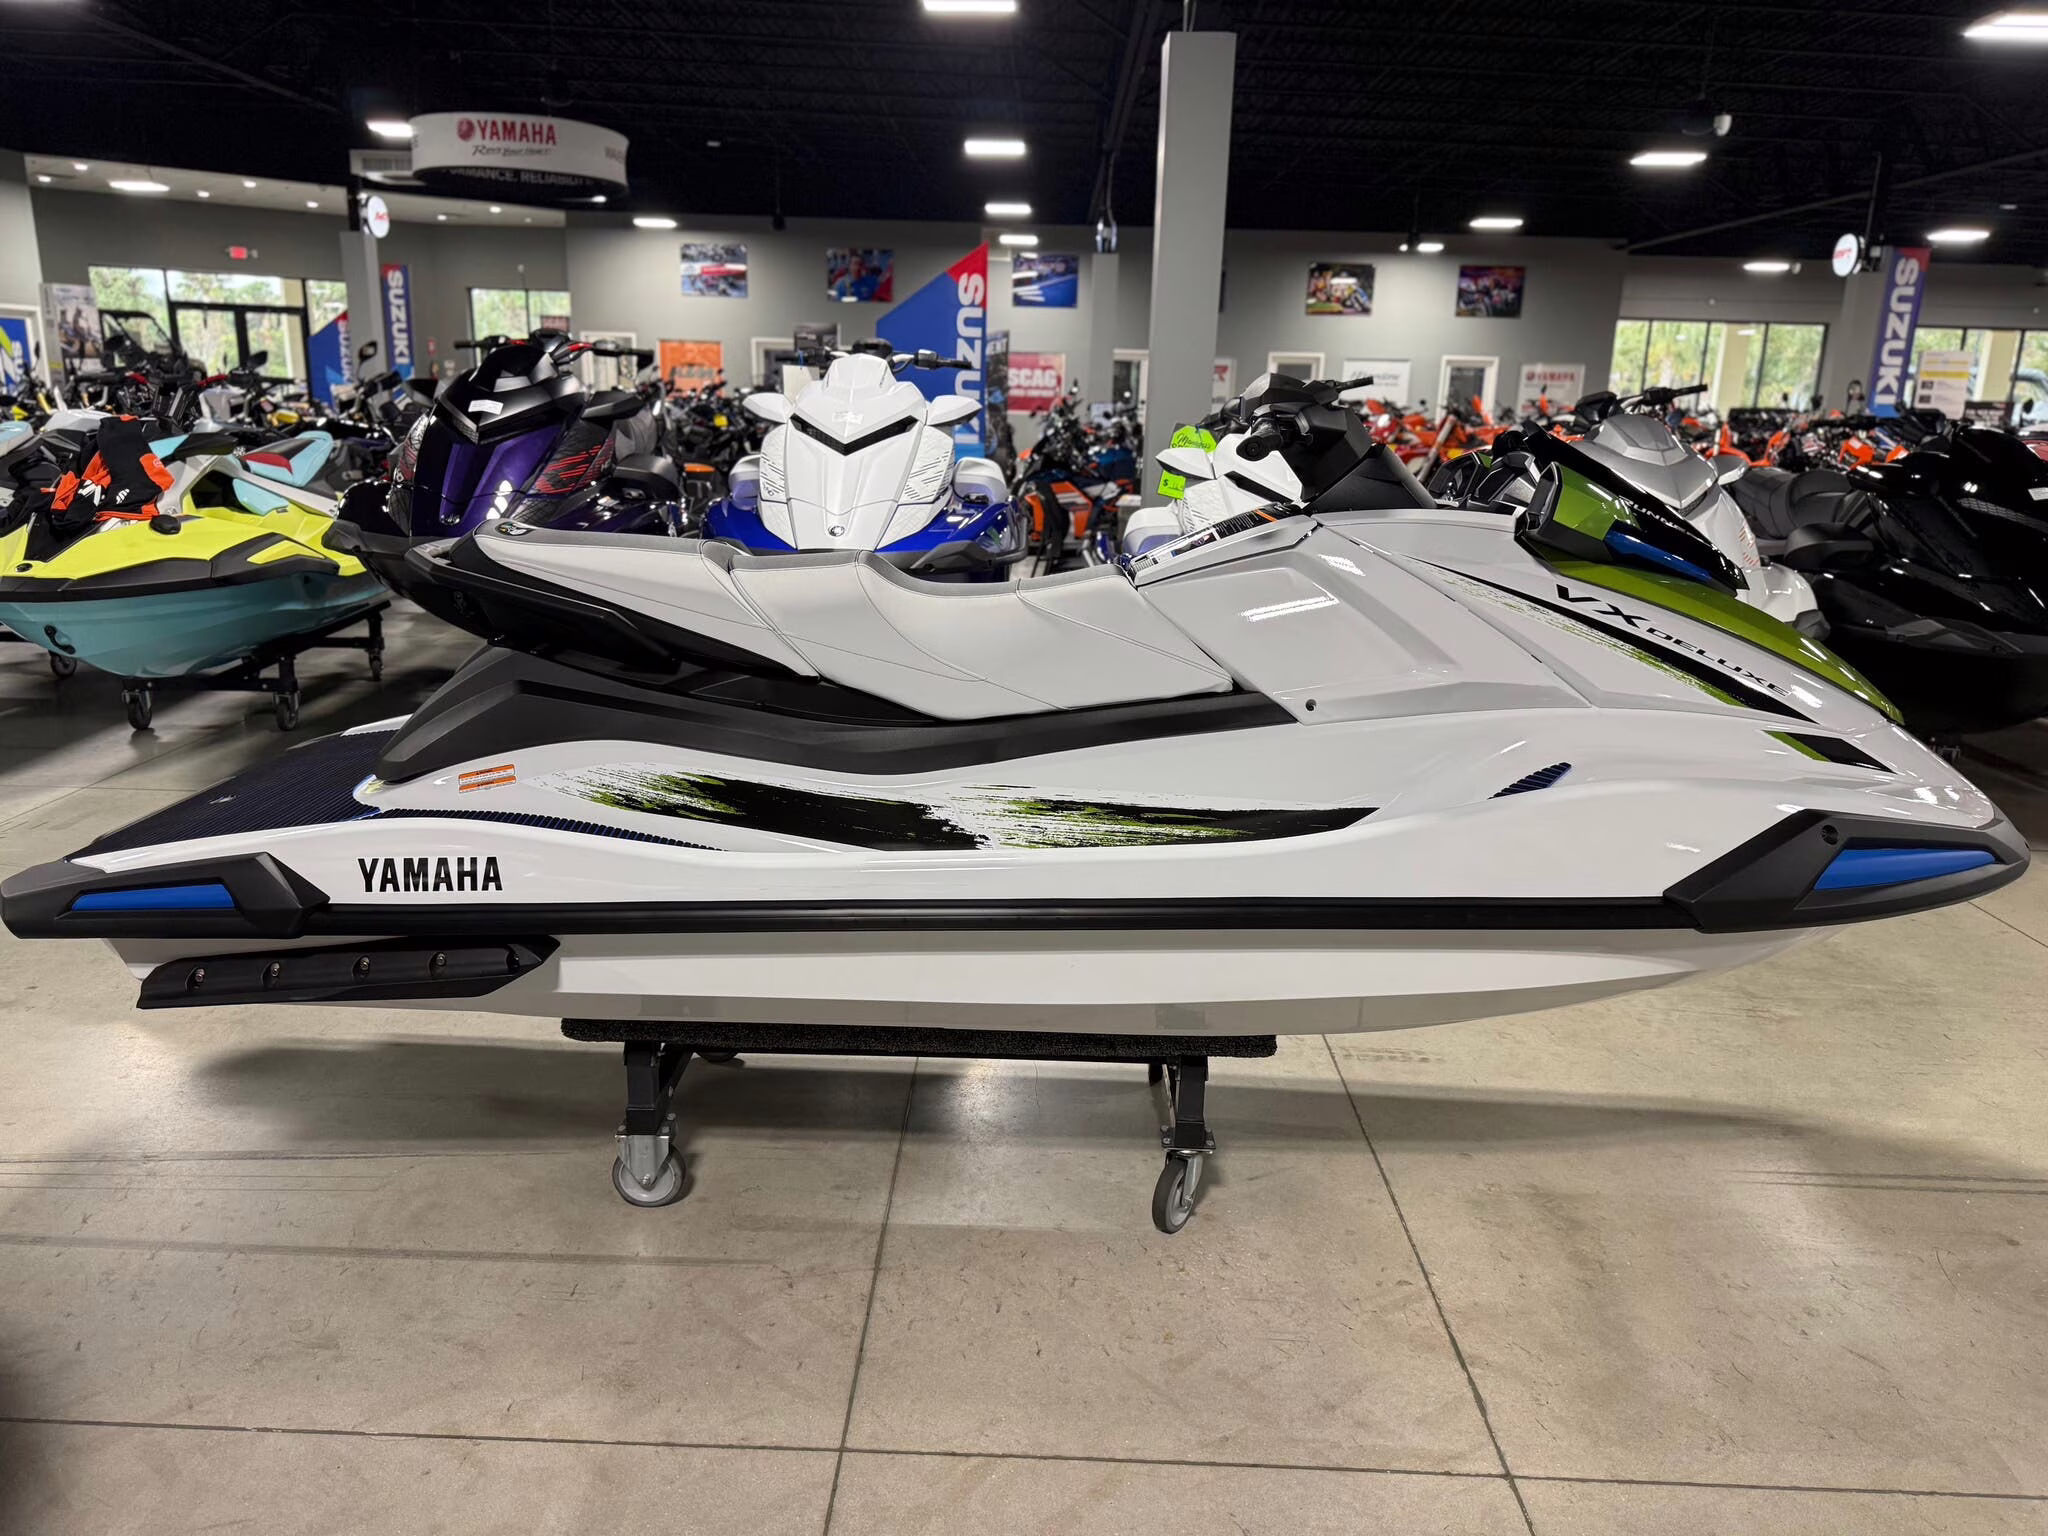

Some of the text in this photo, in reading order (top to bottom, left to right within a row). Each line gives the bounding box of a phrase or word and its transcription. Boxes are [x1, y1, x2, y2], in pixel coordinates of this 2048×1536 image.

[477, 119, 557, 145] YAMAHA
[387, 269, 411, 365] SUZUKI
[1874, 257, 1920, 405] SUZUKI
[1007, 367, 1057, 388] SCAG
[1556, 583, 1792, 697] VX DELUXE
[357, 856, 504, 893] YAMAHA
